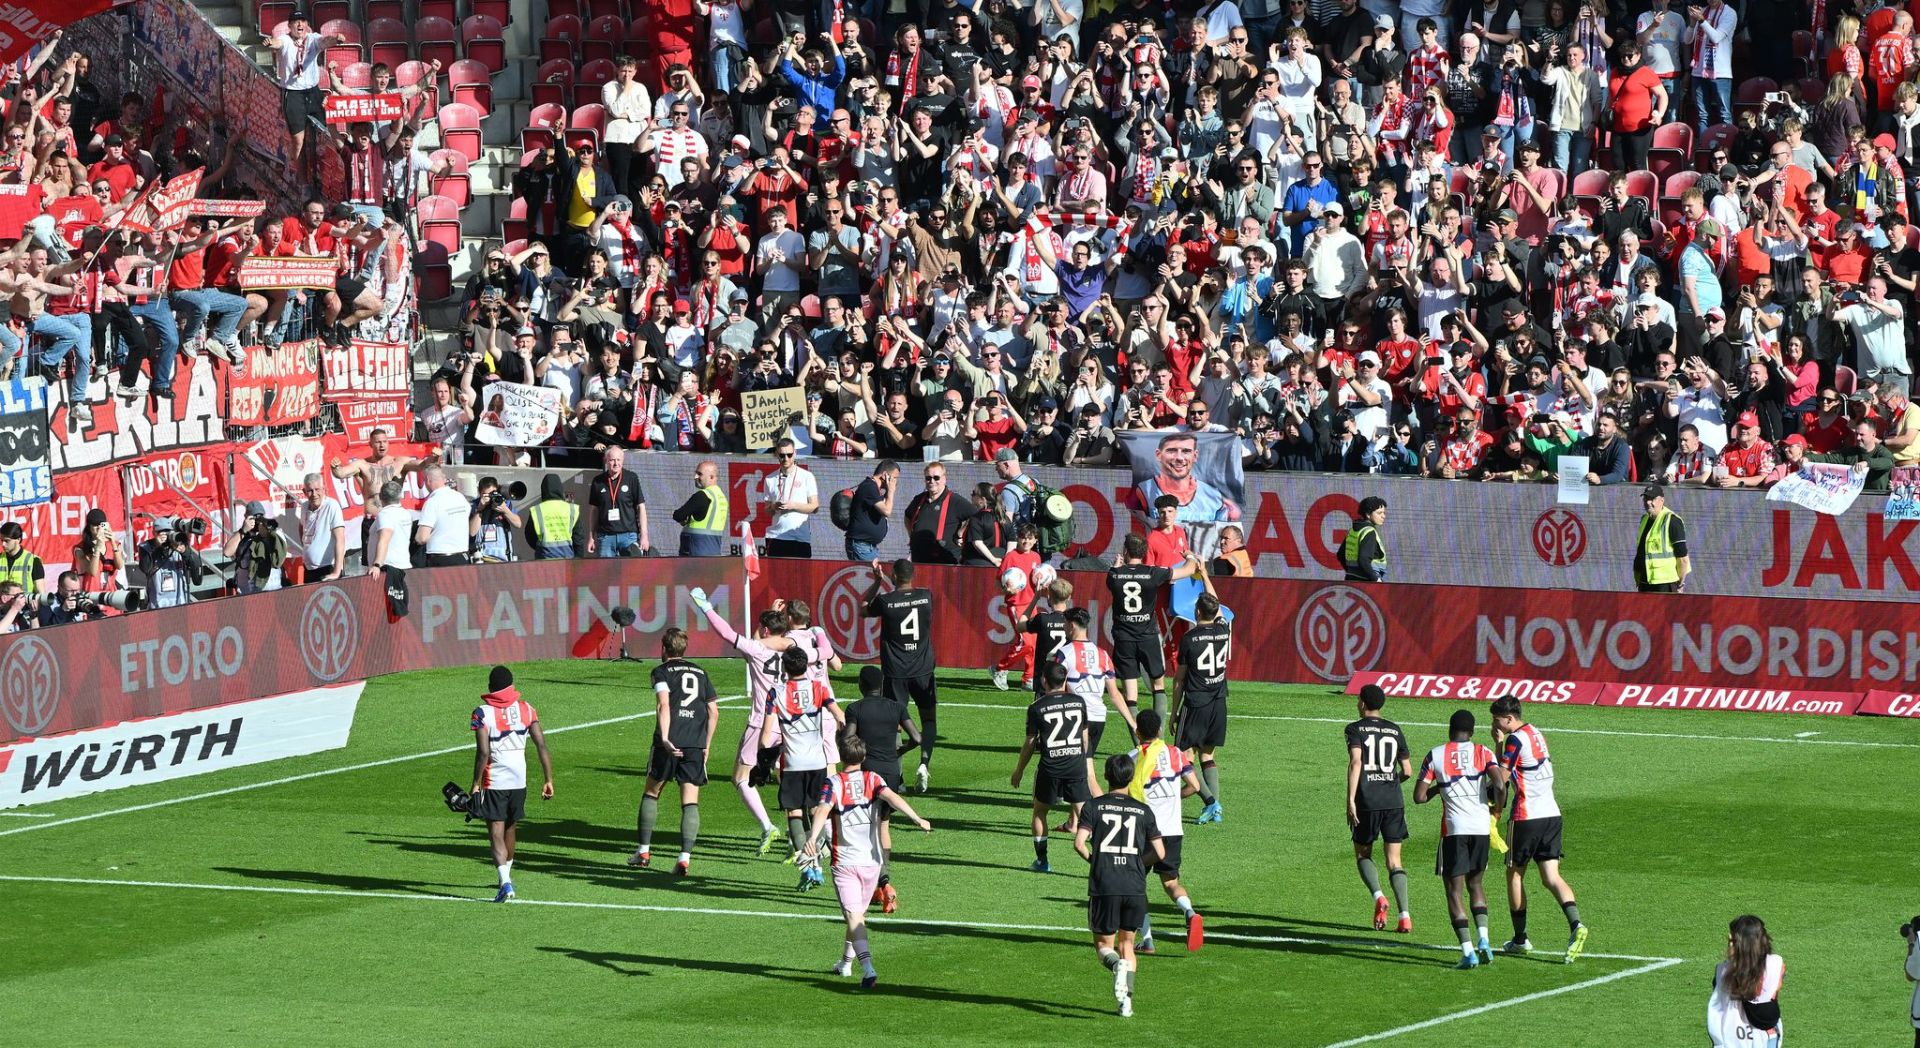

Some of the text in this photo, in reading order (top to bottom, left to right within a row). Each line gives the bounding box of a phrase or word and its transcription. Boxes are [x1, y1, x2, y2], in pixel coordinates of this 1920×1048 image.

[326, 108, 357, 118] IMMER
[380, 106, 401, 115] UNS
[121, 452, 209, 498] ÜDTIROL
[421, 584, 729, 644] PLATINUM
[1123, 581, 1143, 613] 8
[900, 607, 920, 641] 4
[1475, 614, 1651, 671] NOVO
[120, 625, 244, 693] ETORO
[1197, 641, 1229, 677] 44
[680, 672, 699, 707] 9
[1373, 673, 1576, 702] CATS & DOGS
[1616, 684, 1843, 714] PLATINUM.com
[1044, 710, 1082, 748] 22
[20, 717, 243, 794] WÜRTH
[1363, 734, 1398, 773] 10
[1100, 813, 1138, 855] 21
